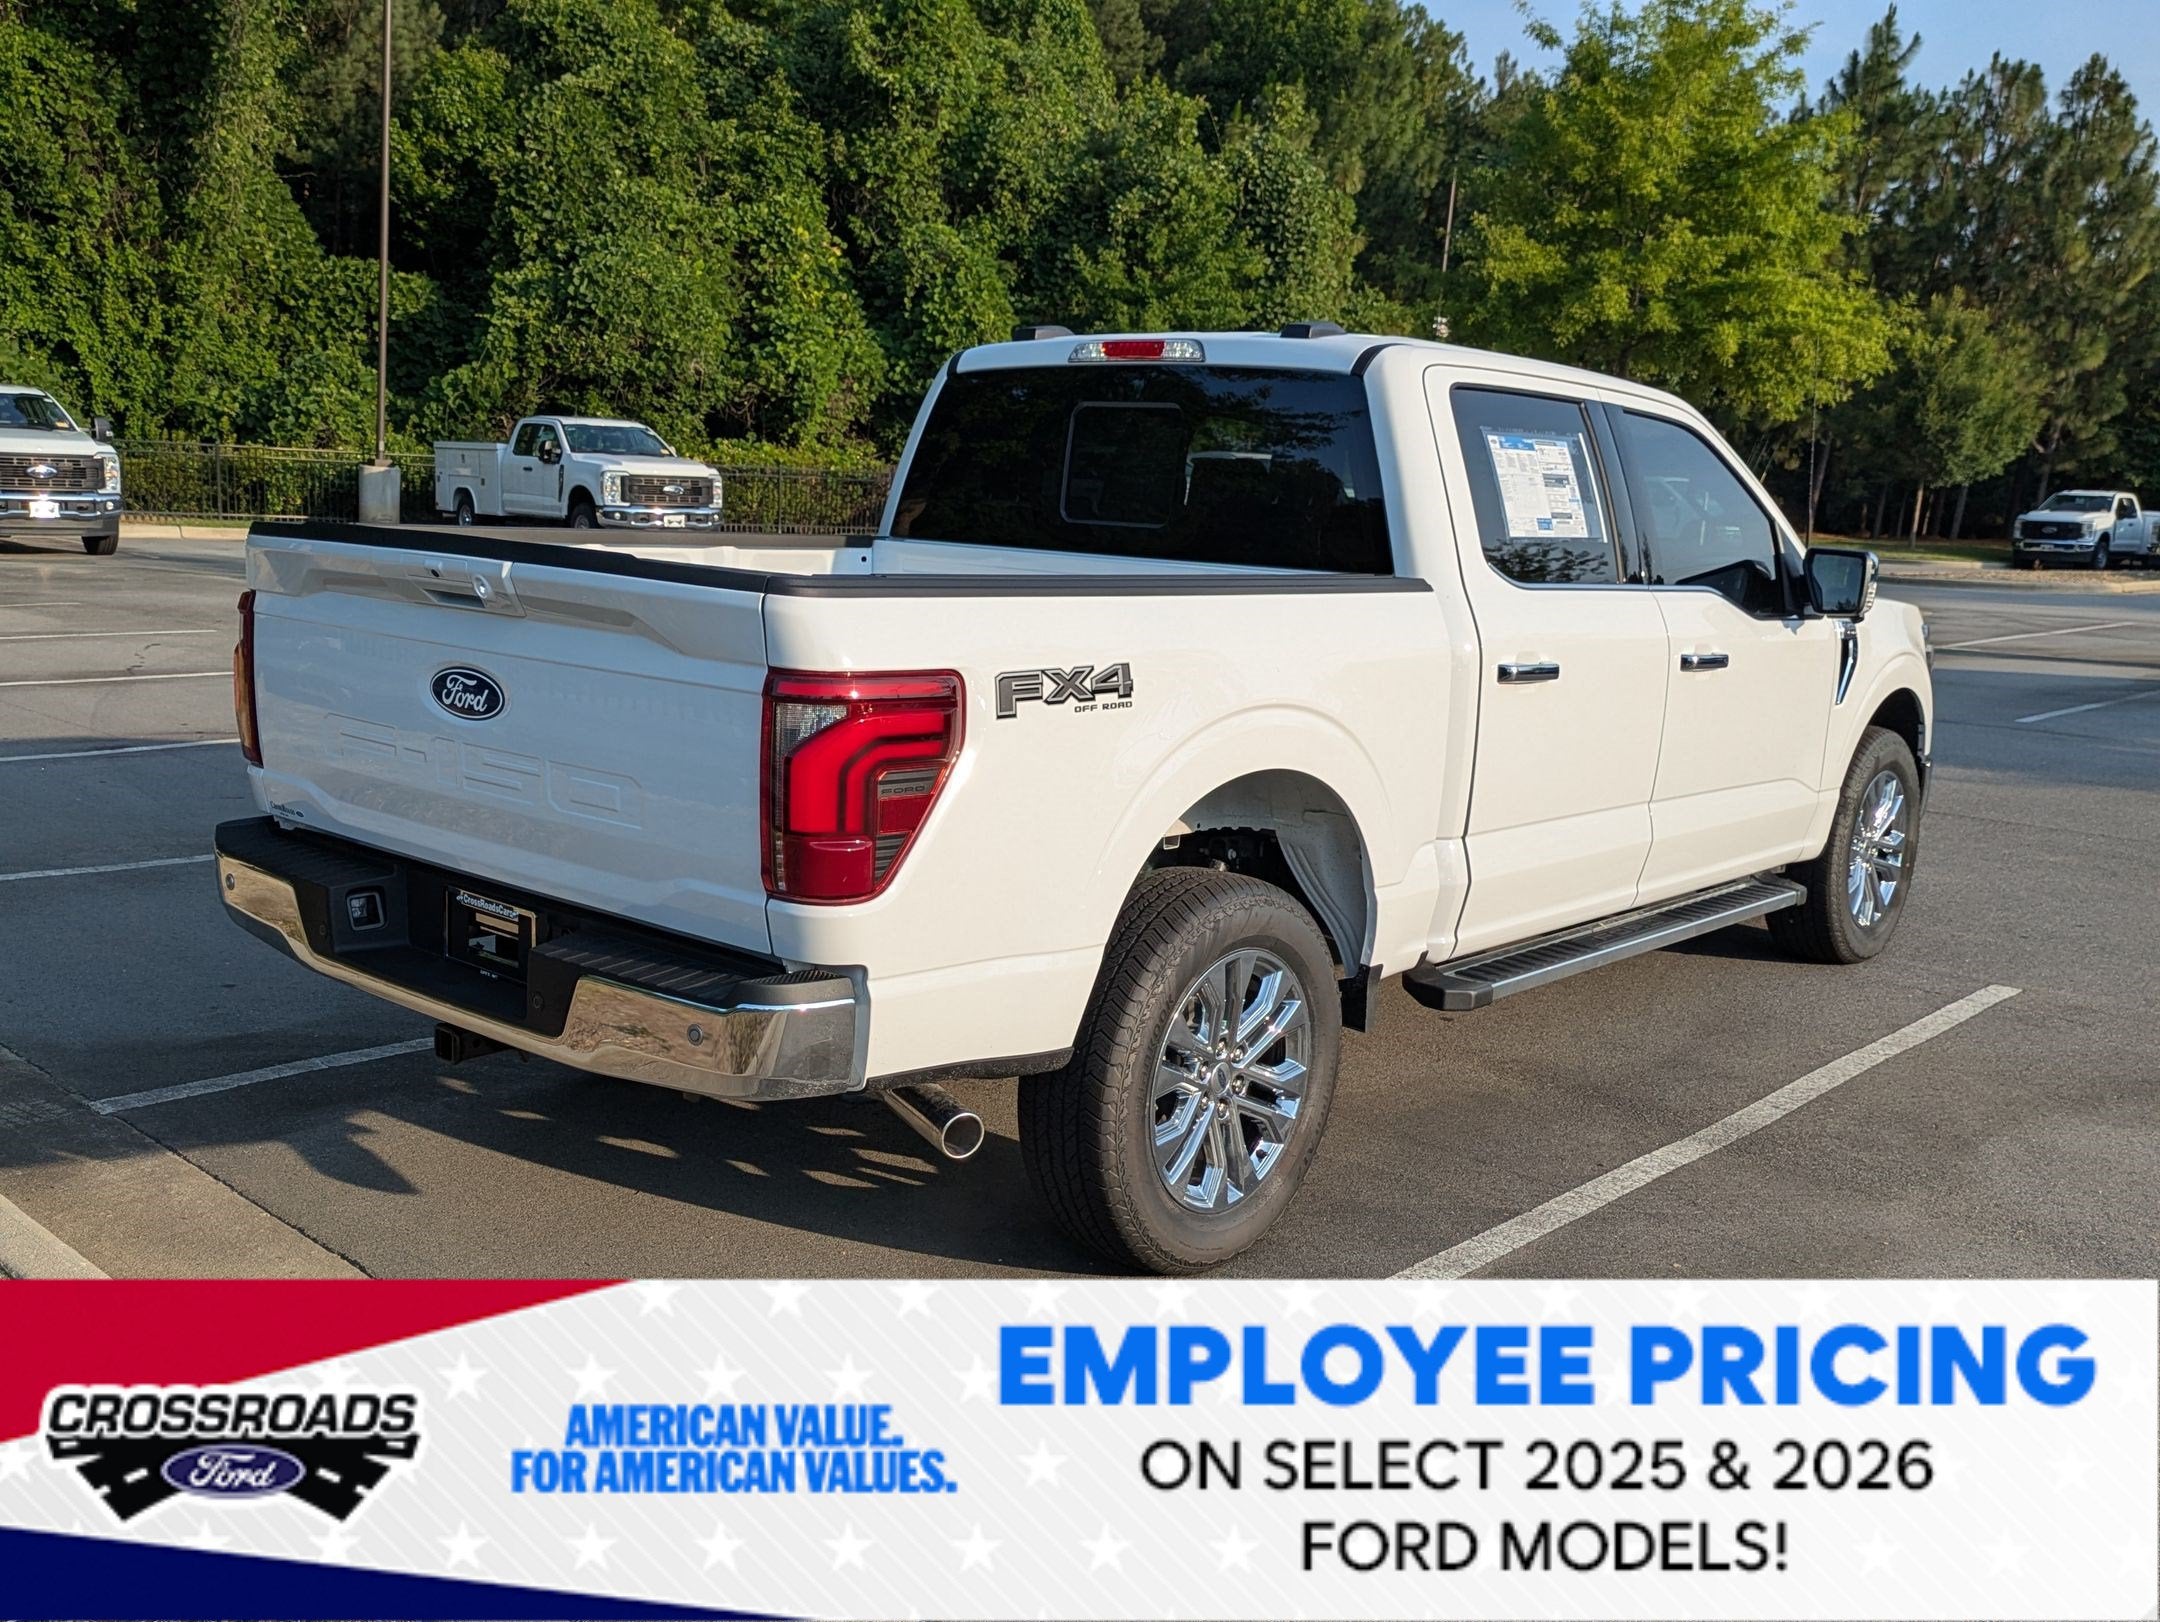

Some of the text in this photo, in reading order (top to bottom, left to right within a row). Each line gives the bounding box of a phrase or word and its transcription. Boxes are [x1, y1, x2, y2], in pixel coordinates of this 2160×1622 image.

[440, 672, 491, 713] Ford
[994, 662, 1134, 720] FX4
[1074, 700, 1134, 714] OFF ROAD
[880, 785, 926, 796] FORD
